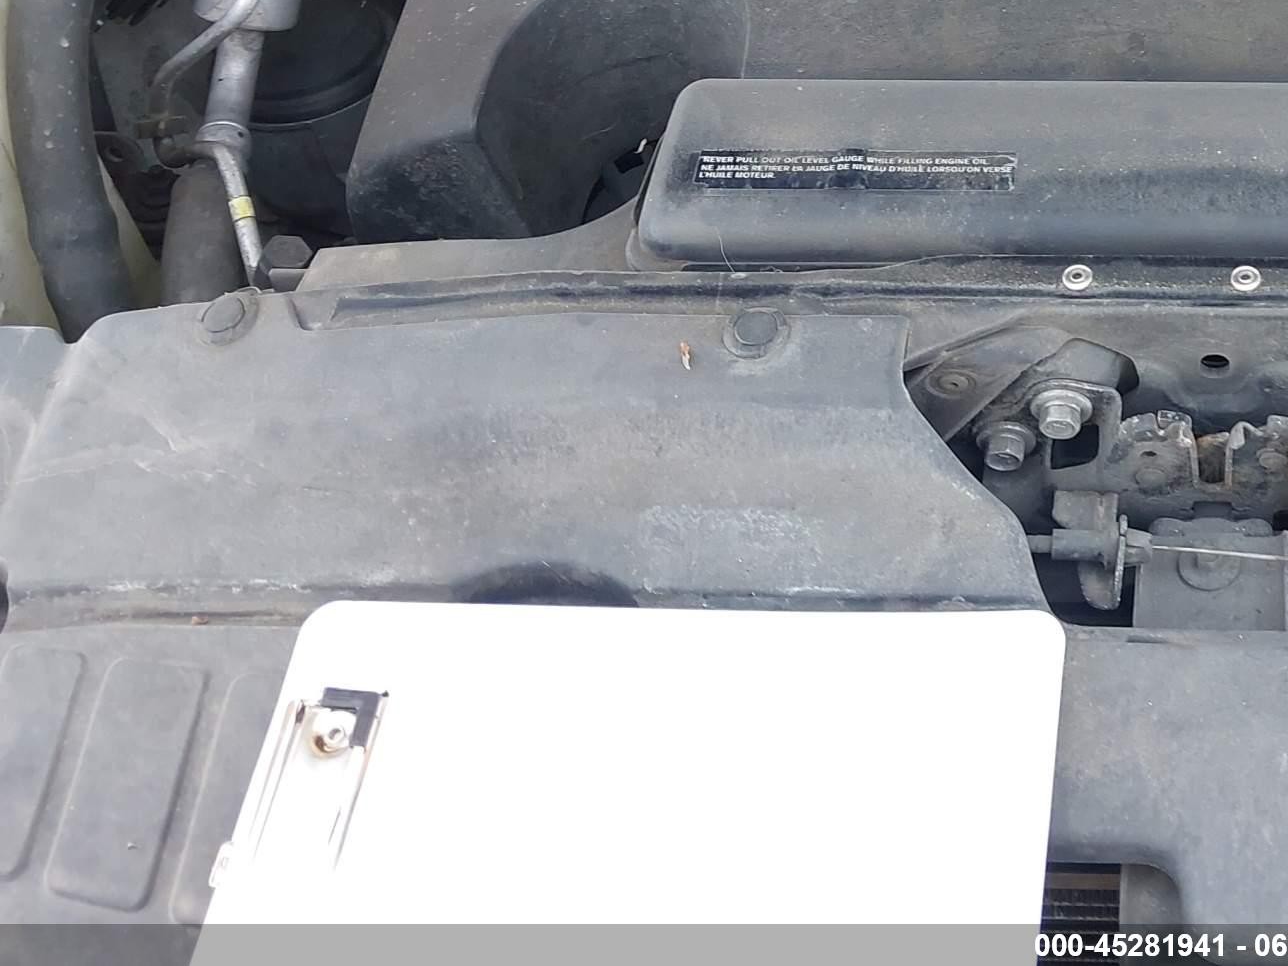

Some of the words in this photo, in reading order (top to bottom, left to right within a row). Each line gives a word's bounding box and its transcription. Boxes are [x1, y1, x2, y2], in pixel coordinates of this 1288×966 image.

[702, 155, 734, 163] NEVER
[735, 155, 759, 163] PULL
[760, 156, 781, 164] OUT
[783, 156, 800, 164] OIL
[801, 156, 829, 164] LEVEL
[832, 154, 864, 163] GAUGE
[866, 156, 895, 165] WHILE
[898, 157, 933, 165] FILLING
[935, 157, 970, 165] ENGINE
[700, 164, 715, 172] NE
[716, 164, 749, 172] JAMAIS
[750, 164, 790, 172] RETIRER
[805, 164, 836, 172] JAUGE
[836, 163, 850, 171] DE
[852, 163, 886, 172] NIVEAU
[699, 171, 733, 179] L'HUILE
